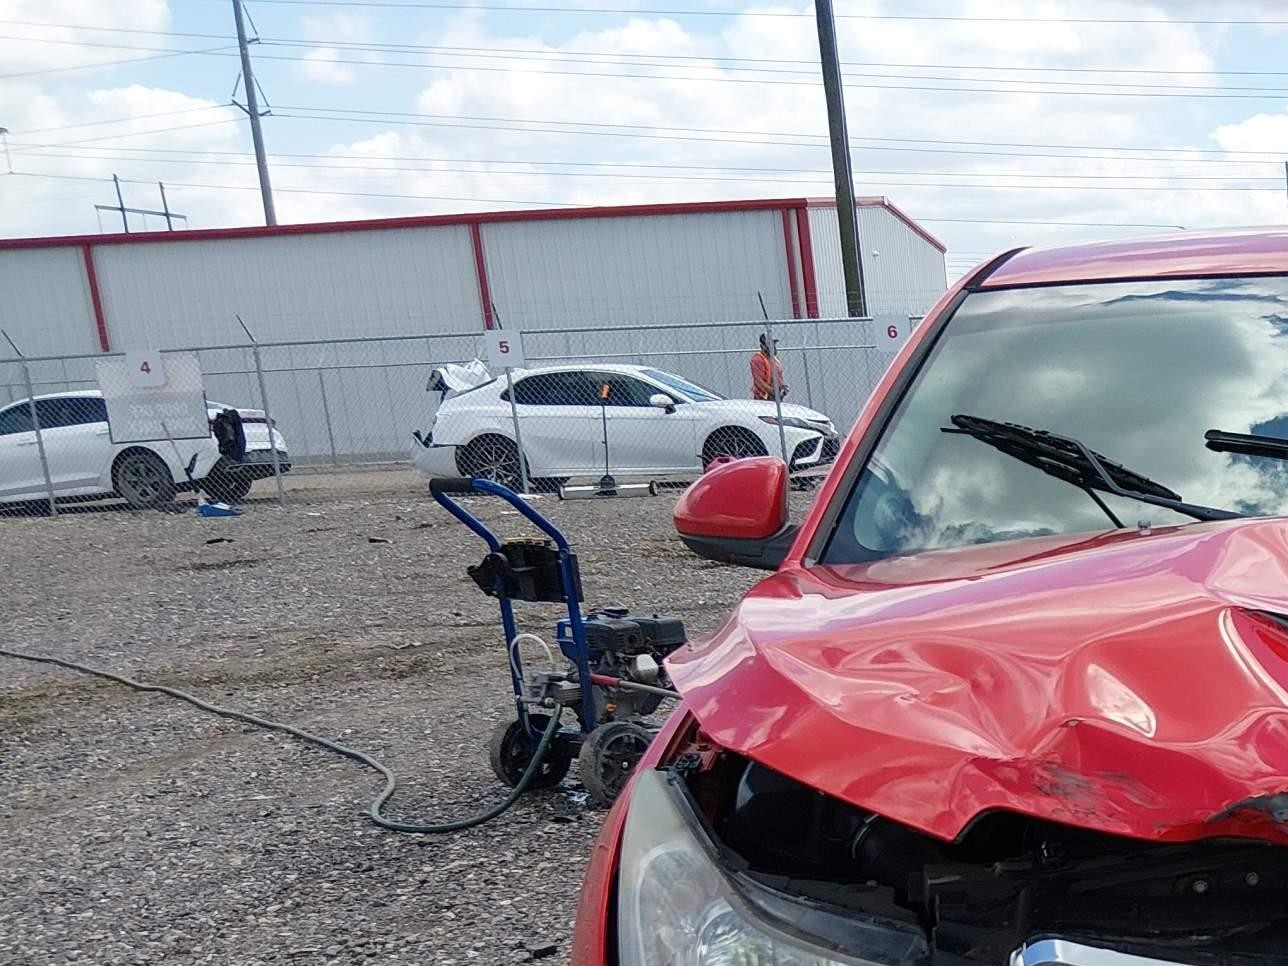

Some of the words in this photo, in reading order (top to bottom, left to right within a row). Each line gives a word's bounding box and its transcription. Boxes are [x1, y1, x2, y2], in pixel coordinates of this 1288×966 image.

[887, 325, 898, 339] 6
[498, 340, 510, 354] 5
[140, 361, 151, 374] 4
